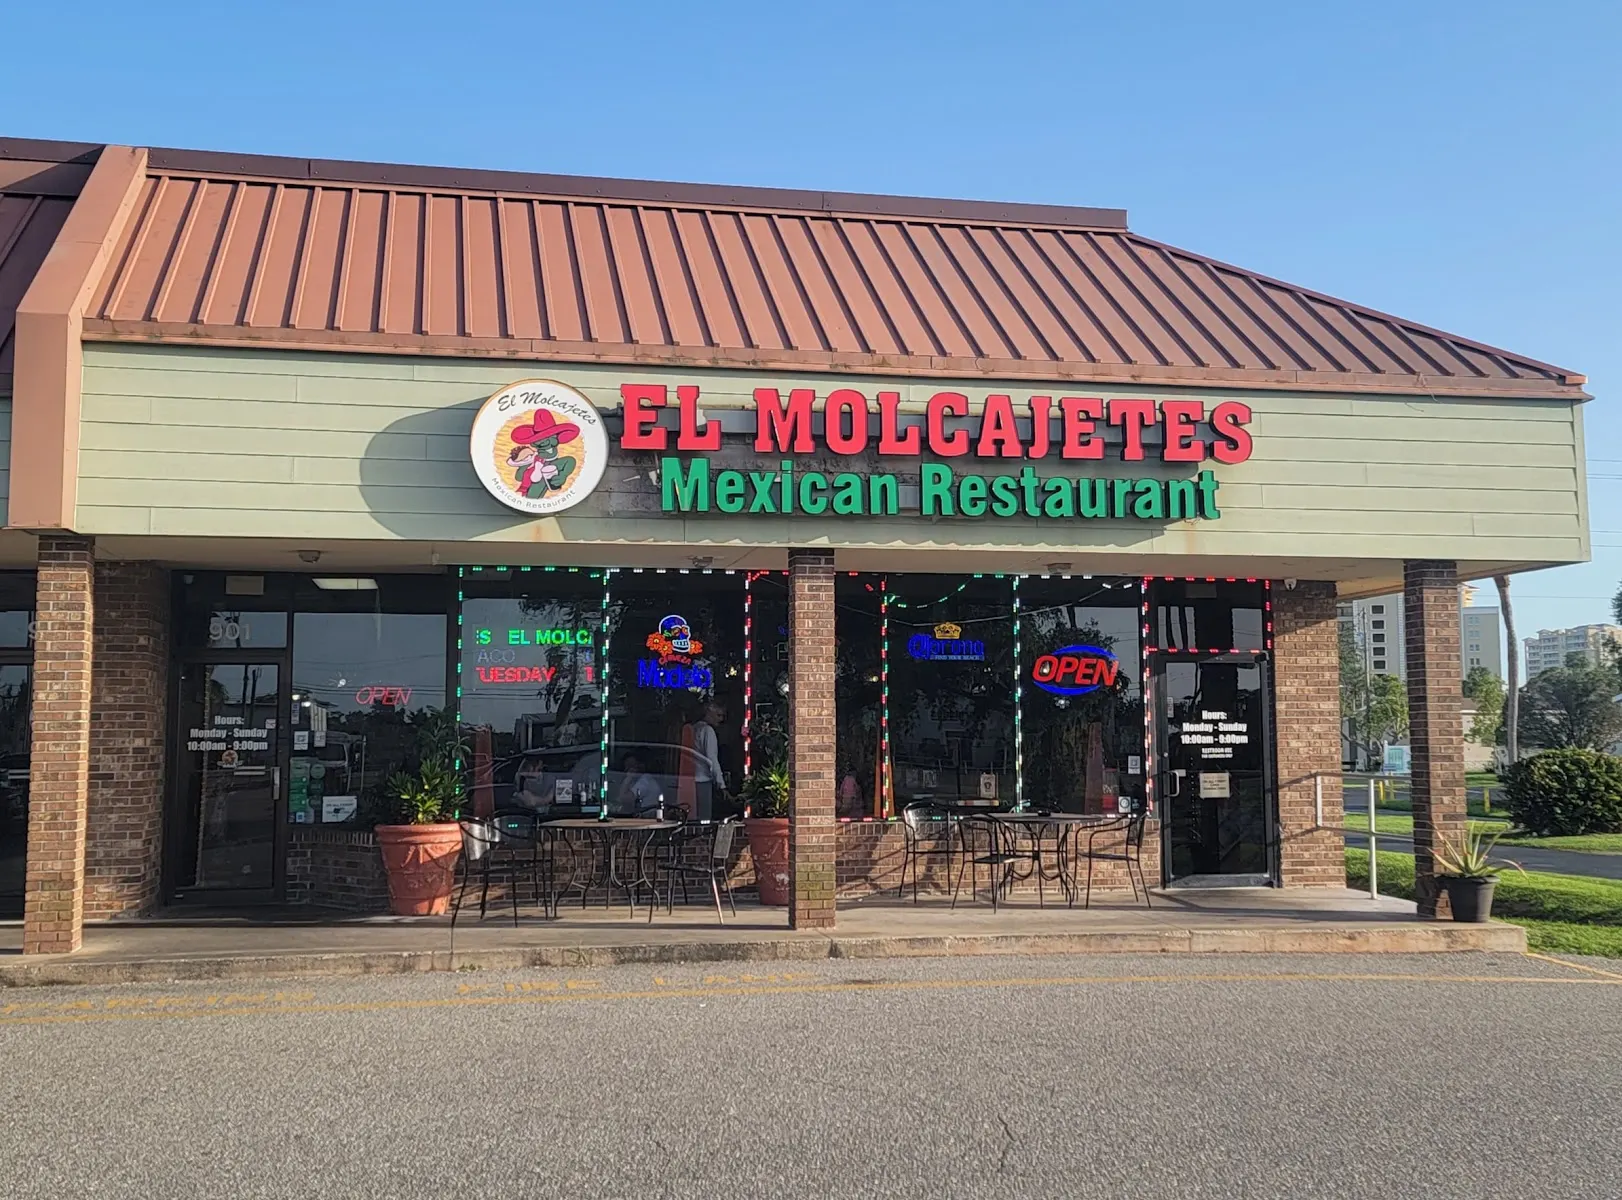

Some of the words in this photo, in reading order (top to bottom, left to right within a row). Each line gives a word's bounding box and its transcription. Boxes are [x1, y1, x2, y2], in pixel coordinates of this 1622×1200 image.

[497, 394, 516, 412] El
[519, 391, 597, 426] Molcajetes
[620, 383, 722, 451] EL
[754, 388, 1253, 465] MOLCAJETES
[491, 477, 523, 506] Mexican
[525, 488, 577, 509] Restaurant
[661, 456, 900, 515] Mexican
[920, 462, 1221, 520] Restaurant
[209, 621, 251, 641] 901
[508, 628, 531, 645] EL
[907, 632, 985, 660] Corona
[1033, 655, 1118, 686] OPEN
[355, 686, 413, 707] OPEN
[214, 715, 245, 725] Hours:
[1201, 710, 1227, 720] Hours:
[189, 728, 227, 739] Monday
[233, 728, 268, 739] Sunday
[1182, 722, 1213, 732] Monday
[1218, 722, 1247, 732] Sunday
[187, 741, 227, 751] 10:00am
[233, 740, 269, 751] 9:00pm
[1180, 734, 1214, 745] 10:00am
[1218, 734, 1249, 744] 9:00pm
